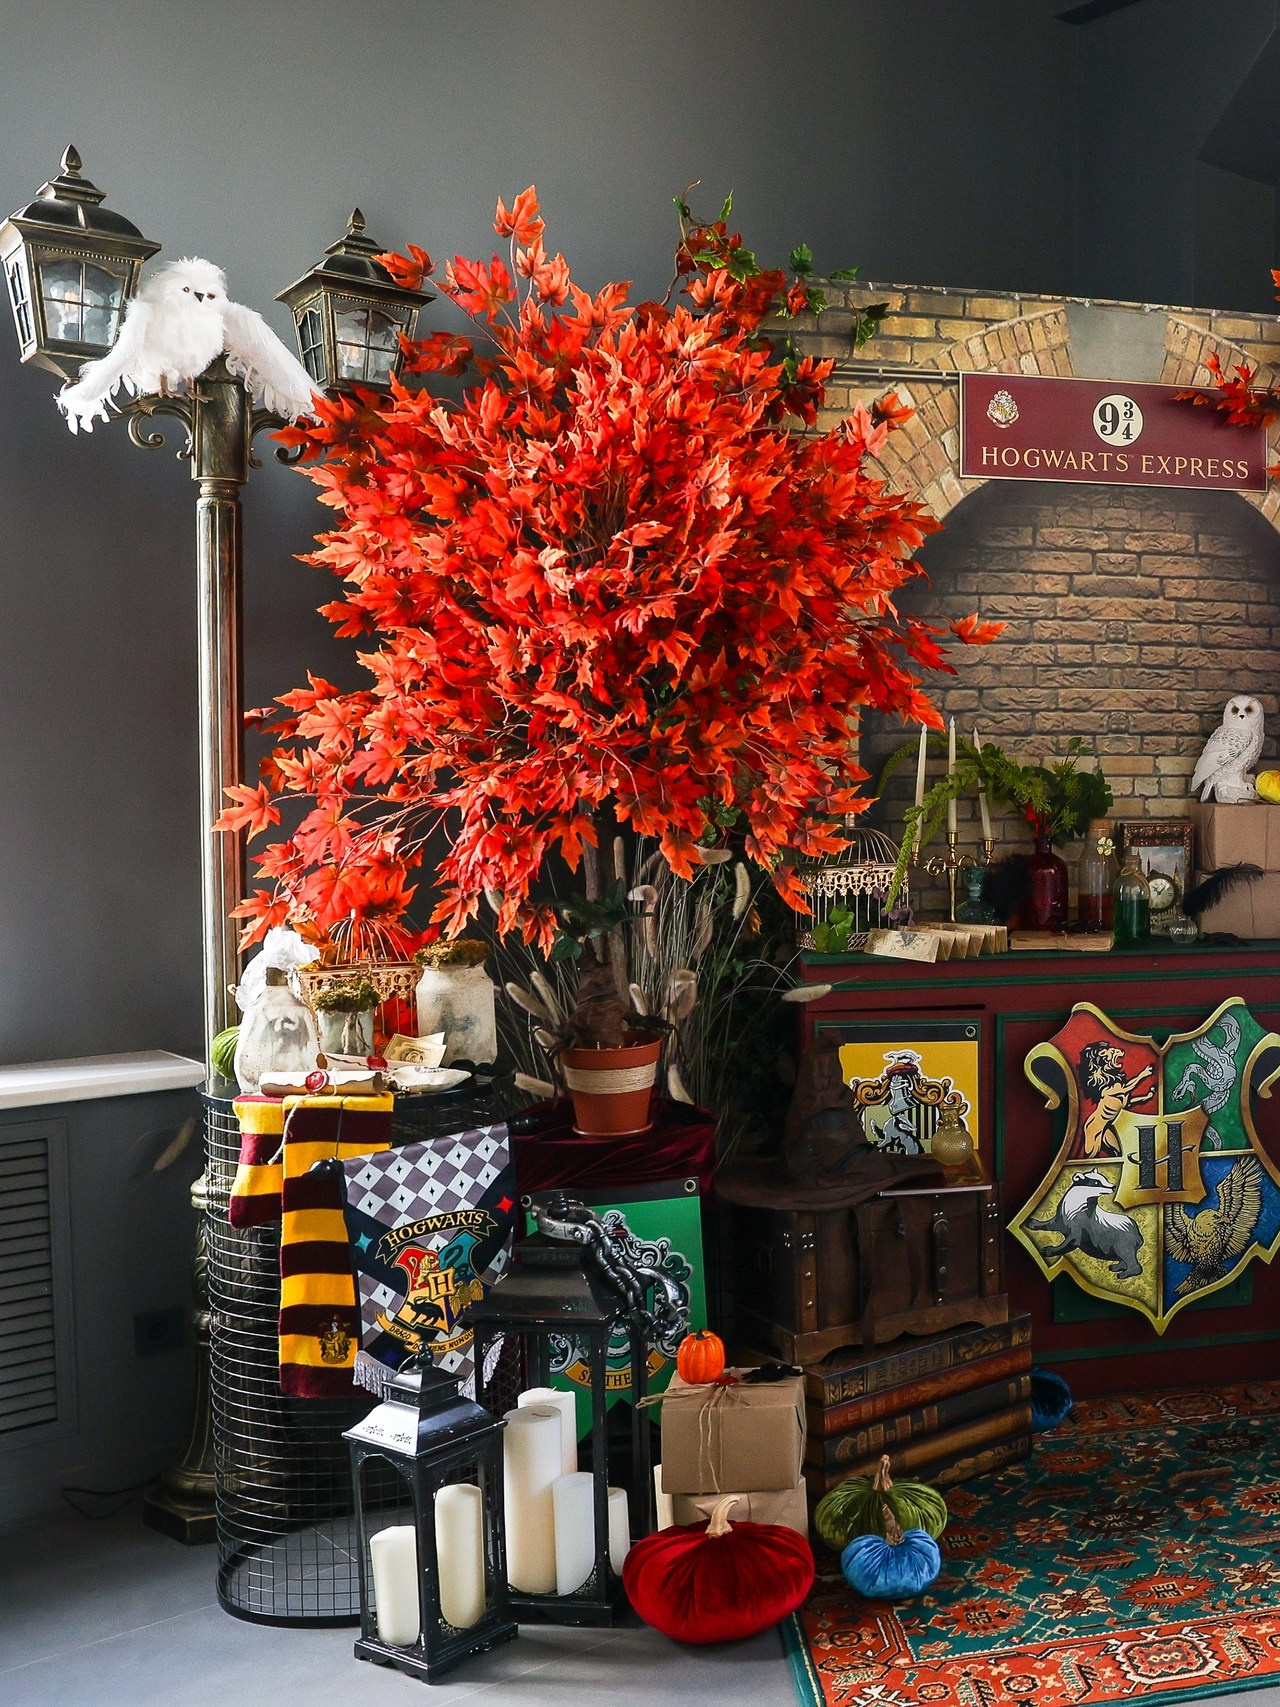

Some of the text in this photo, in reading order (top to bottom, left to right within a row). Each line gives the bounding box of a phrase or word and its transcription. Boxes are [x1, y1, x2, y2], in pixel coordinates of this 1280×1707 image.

[981, 446, 1250, 480] HOGWARTS EXPRESS
[384, 1211, 484, 1248] HOGWARTS
[431, 1273, 452, 1296] H
[388, 1325, 412, 1340] DRAGO
[448, 1330, 474, 1349] NUNQU
